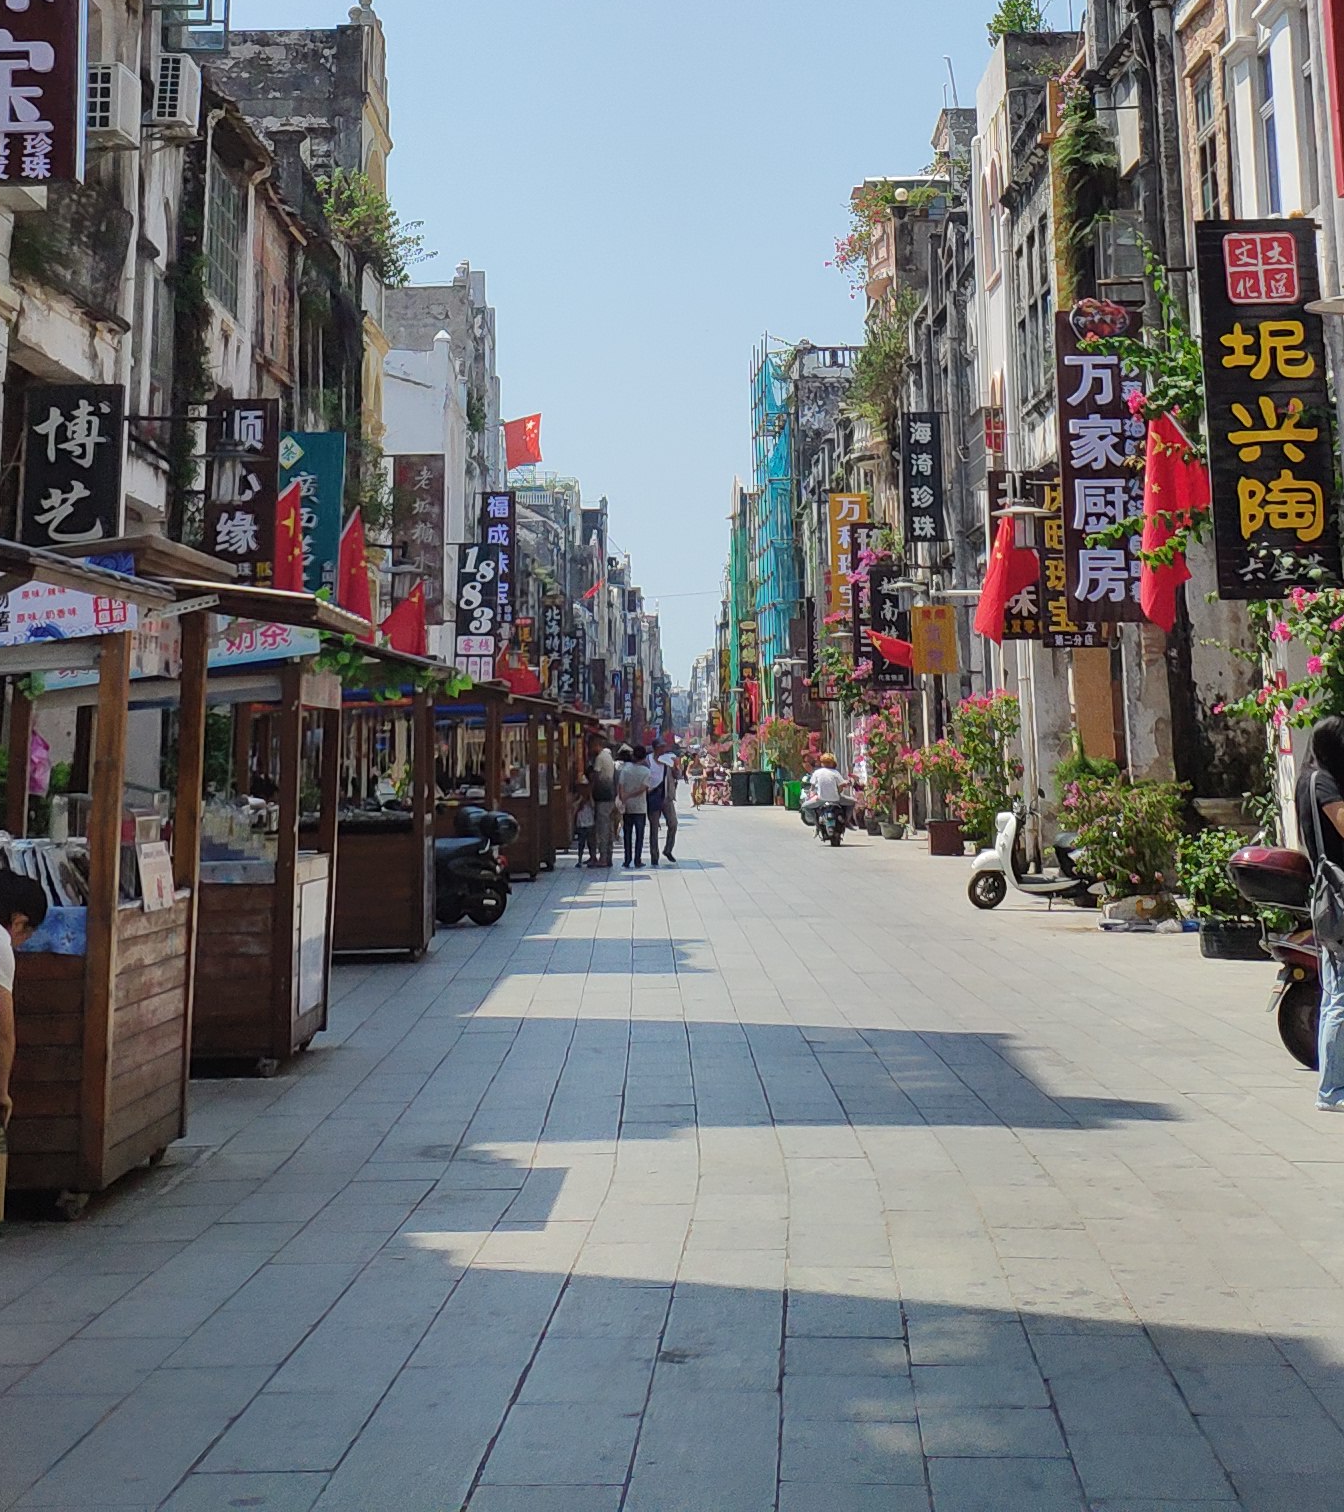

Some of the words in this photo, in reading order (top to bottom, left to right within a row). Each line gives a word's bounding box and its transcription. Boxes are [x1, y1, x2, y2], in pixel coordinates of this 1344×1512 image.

[22, 132, 51, 180] 珍珠
[32, 399, 112, 543] 博艺
[1064, 355, 1129, 604] 万家厨房
[1220, 320, 1325, 542] 坭兴陶
[460, 546, 495, 634] 1883
